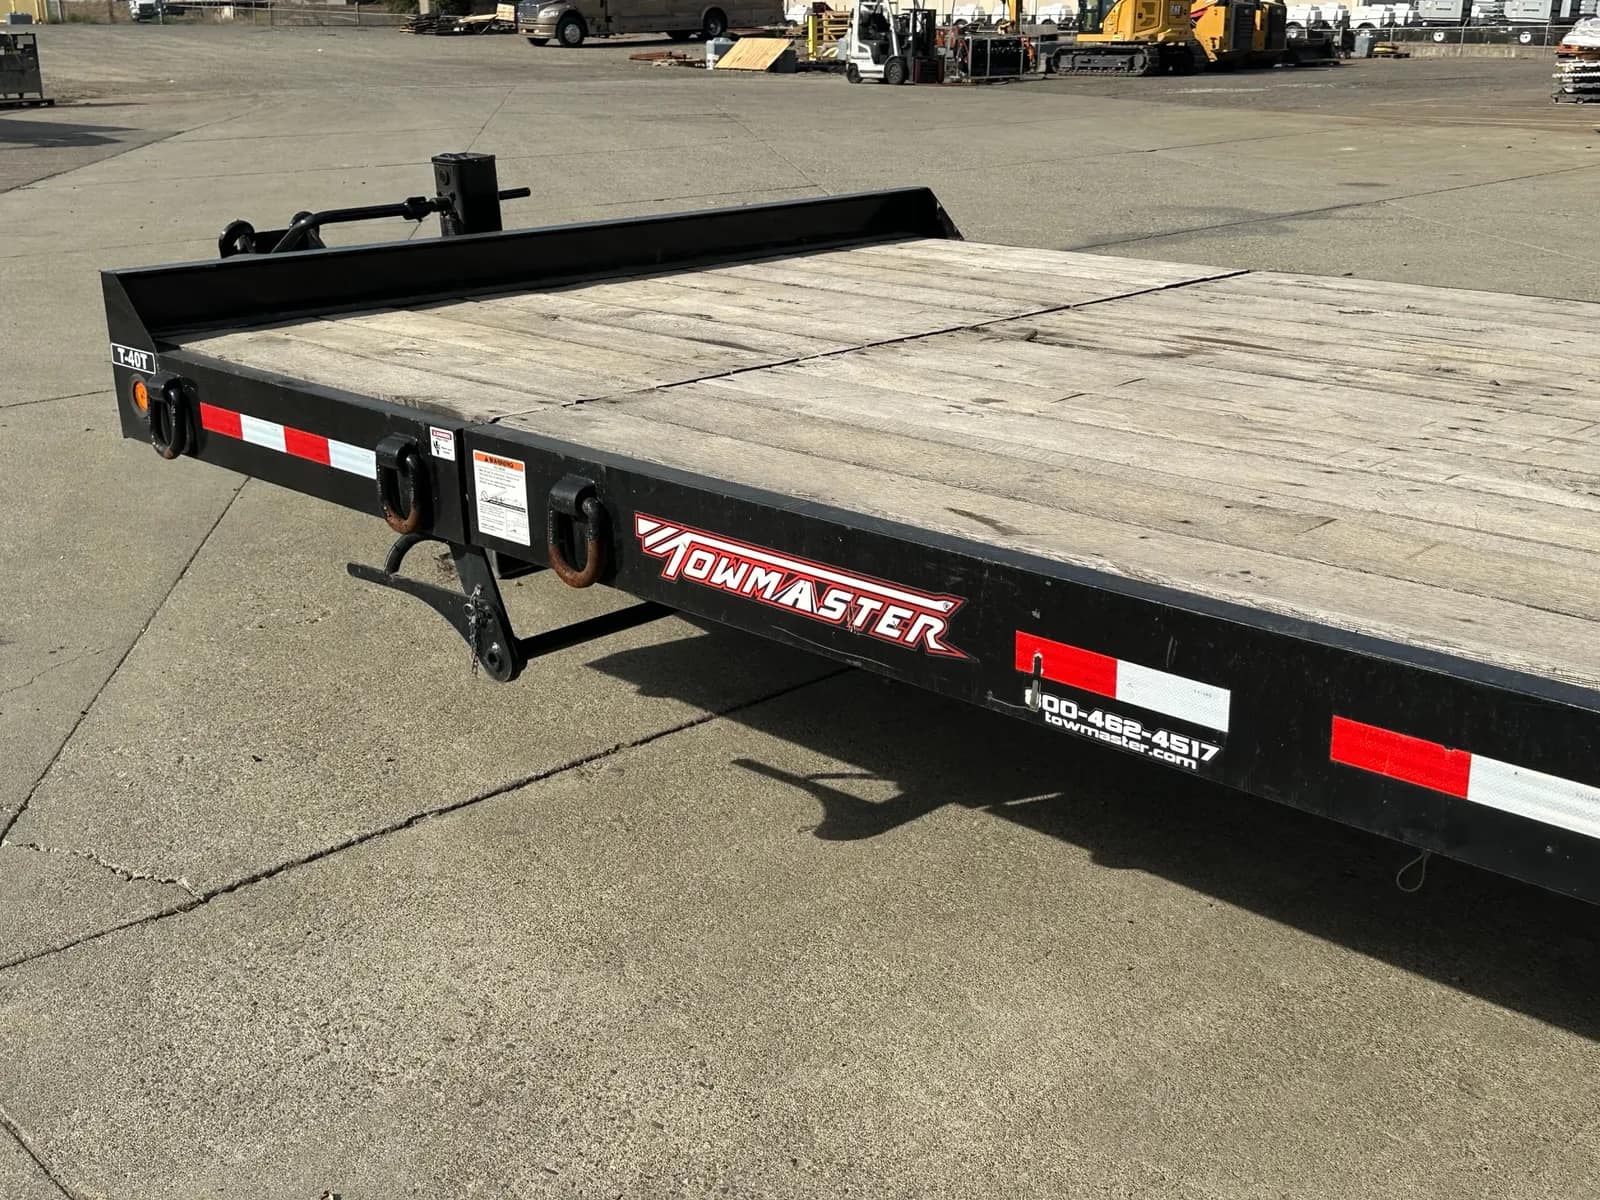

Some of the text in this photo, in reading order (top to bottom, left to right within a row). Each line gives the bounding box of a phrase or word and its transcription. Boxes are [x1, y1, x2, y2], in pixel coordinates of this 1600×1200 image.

[117, 347, 148, 370] T-40T
[635, 514, 957, 657] TOWMASTER
[1044, 711, 1197, 770] towmaster.com
